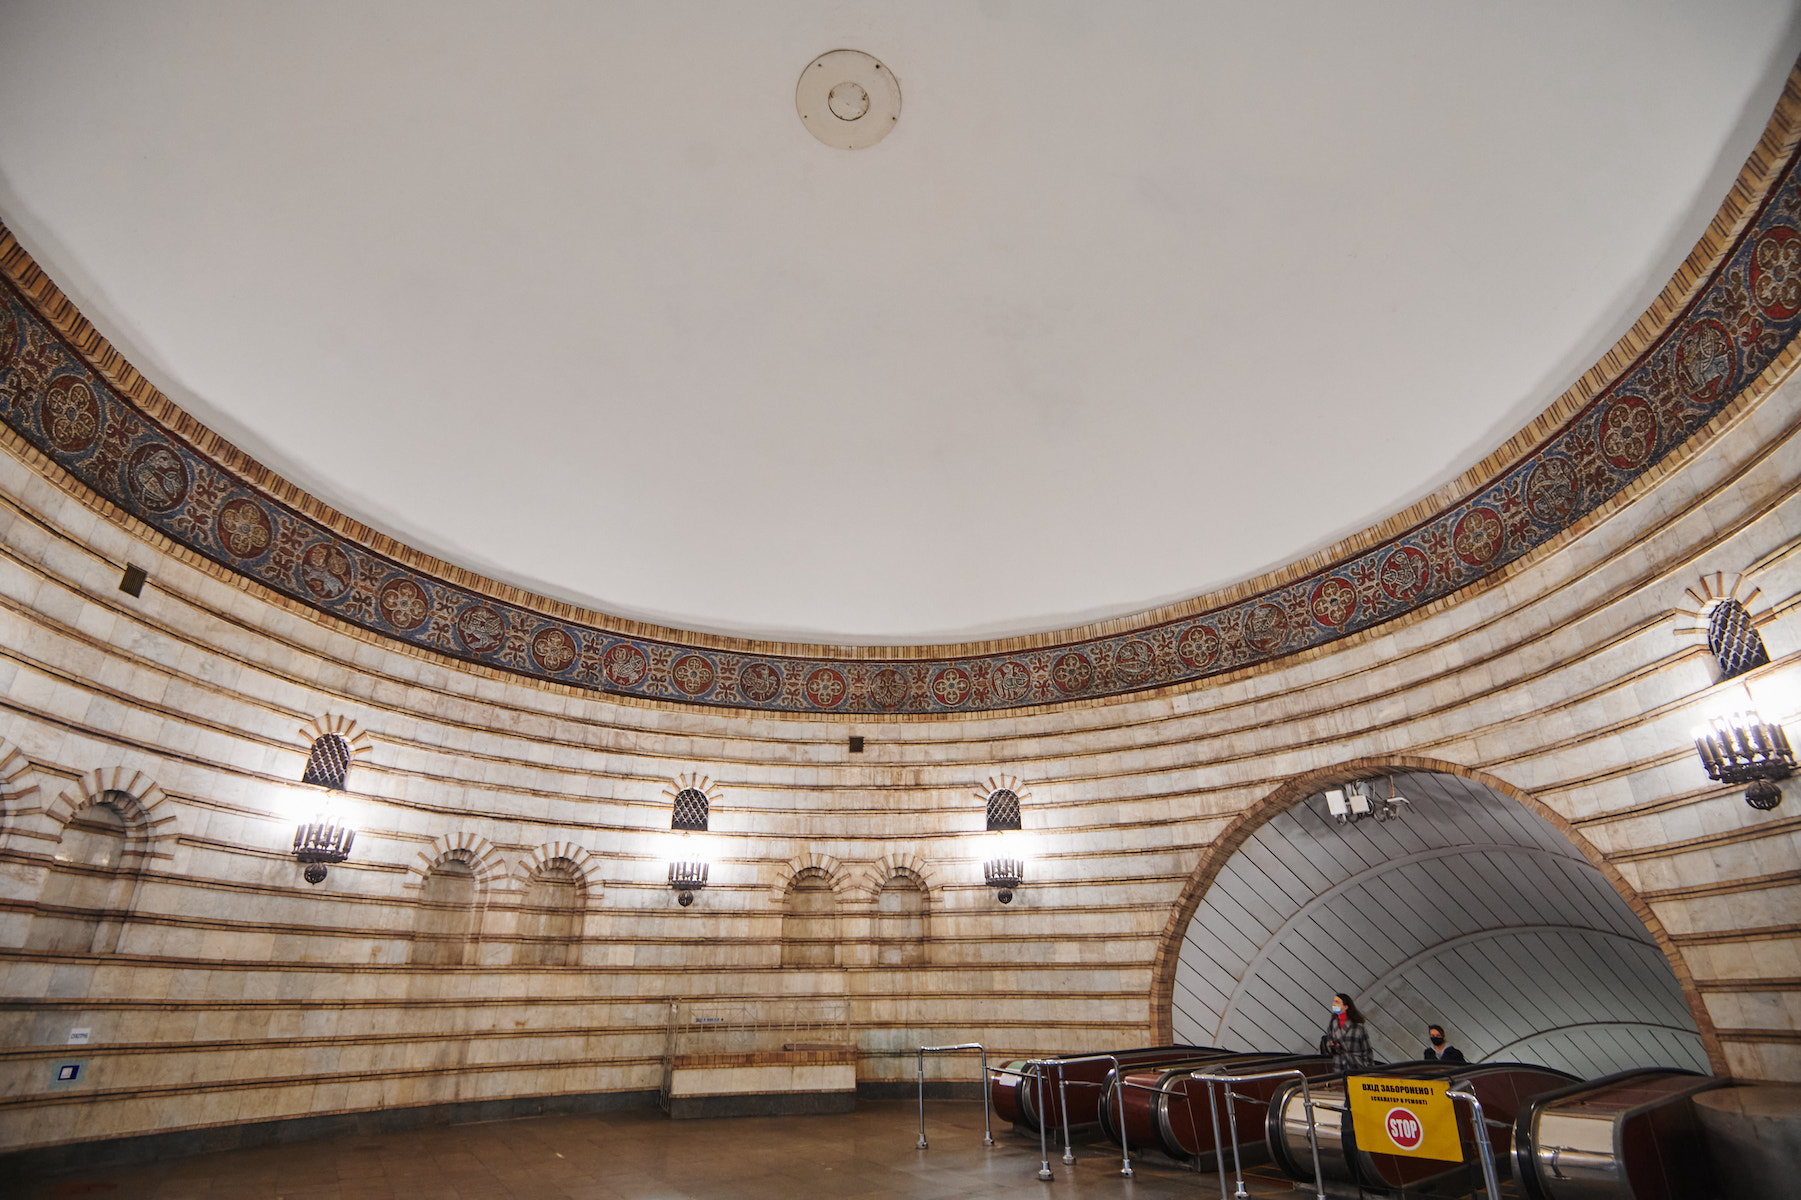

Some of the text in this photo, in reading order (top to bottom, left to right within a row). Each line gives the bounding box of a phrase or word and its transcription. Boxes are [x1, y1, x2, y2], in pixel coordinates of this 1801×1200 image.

[1362, 1083, 1380, 1092] ВХІД
[1380, 1085, 1429, 1095] ЗАБОРОНЕНО
[1389, 1118, 1418, 1139] STOP
